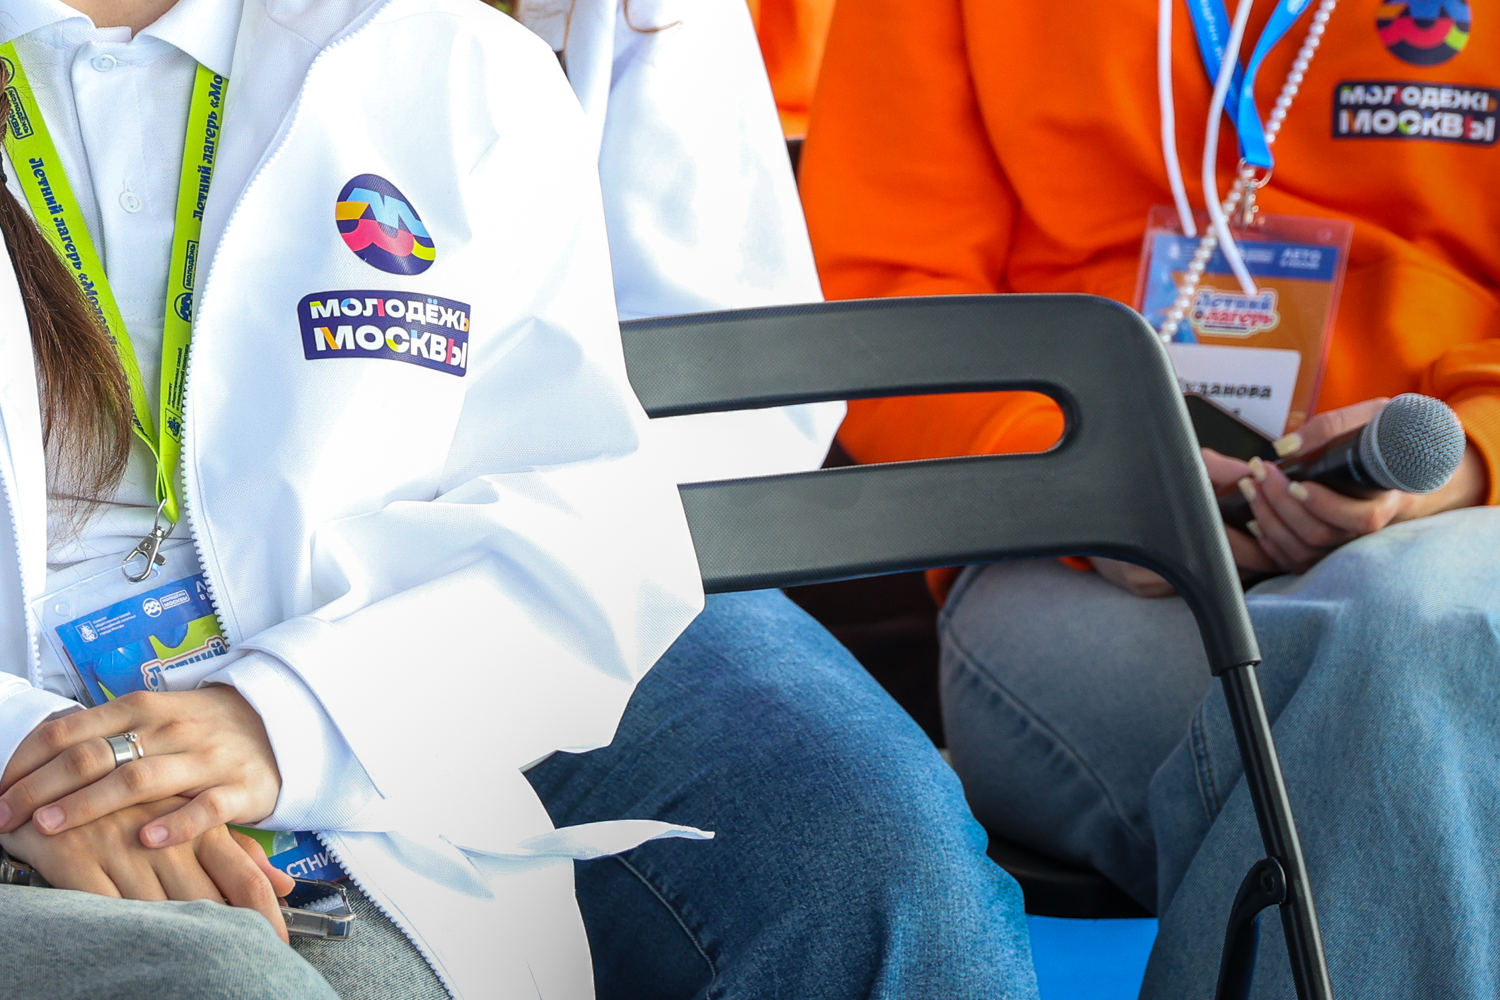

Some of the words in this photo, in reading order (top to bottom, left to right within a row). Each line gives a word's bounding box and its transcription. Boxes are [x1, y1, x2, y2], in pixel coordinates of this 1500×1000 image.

[1338, 109, 1496, 142] МОСКВЫ
[193, 165, 213, 222] Летний
[203, 111, 220, 165] лагерь
[29, 157, 65, 215] Летний
[53, 216, 82, 270] лагерь
[313, 324, 468, 369] МОСКВЫ
